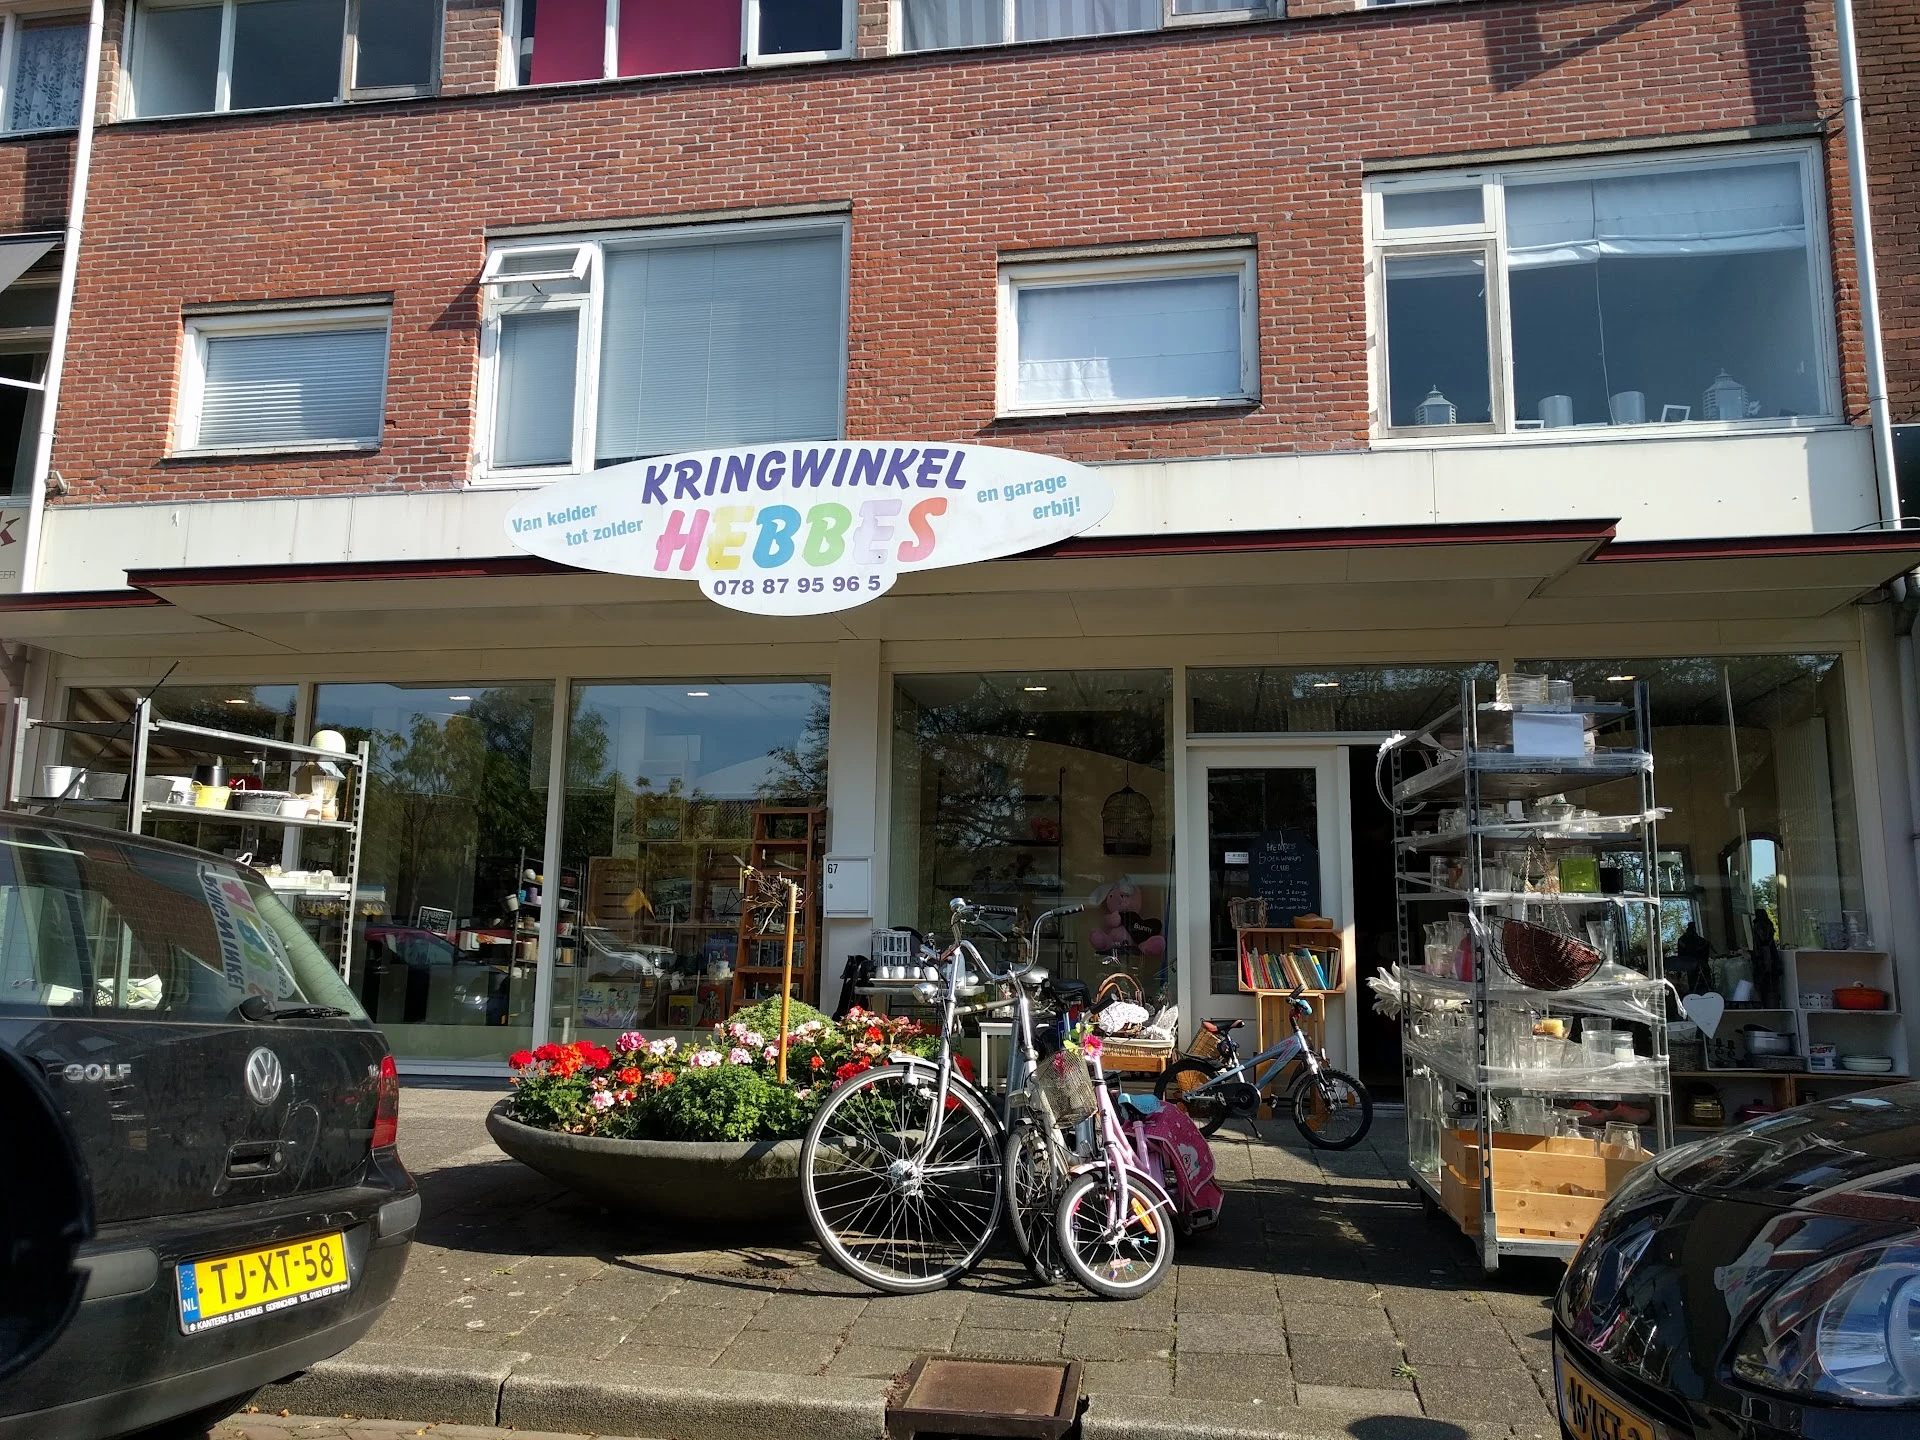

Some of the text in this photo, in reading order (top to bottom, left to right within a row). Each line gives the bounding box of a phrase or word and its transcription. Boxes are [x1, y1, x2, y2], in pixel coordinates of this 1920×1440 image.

[641, 448, 967, 506] KRINGWINKEL
[976, 475, 1067, 503] en garage
[512, 504, 598, 533] Van kelder
[1032, 495, 1081, 520] erbij!
[566, 518, 644, 546] tot zolder
[653, 497, 948, 572] HEBBES
[713, 575, 881, 596] 078 87 95 96 5
[827, 863, 838, 874] 67
[63, 1063, 132, 1081] GOLF
[210, 1242, 334, 1304] TJ-XT-58
[183, 1297, 198, 1312] NL
[197, 1314, 228, 1331] KANTERS
[228, 1312, 234, 1322] &
